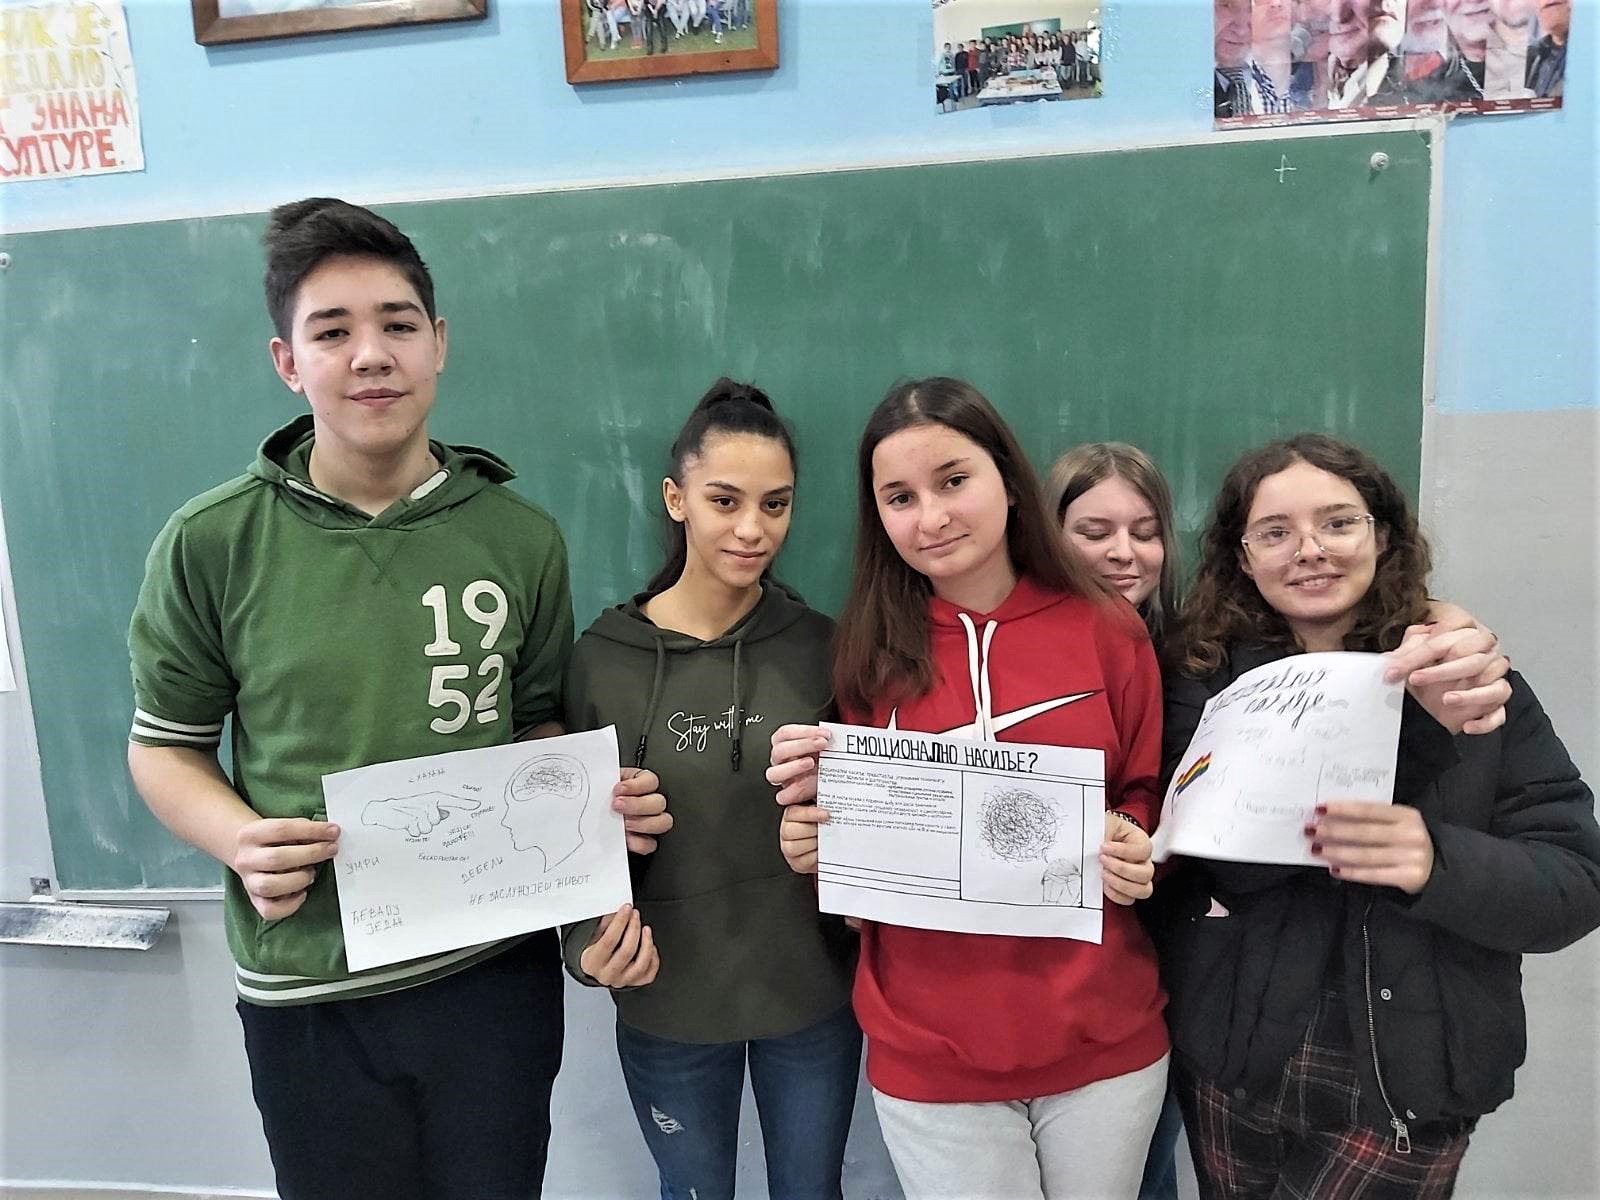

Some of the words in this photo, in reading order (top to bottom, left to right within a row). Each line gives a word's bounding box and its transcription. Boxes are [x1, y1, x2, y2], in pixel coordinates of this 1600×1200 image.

[421, 579, 509, 657] 19
[428, 653, 504, 735] 52
[667, 710, 711, 752] Stay
[846, 734, 958, 764] ЕМОЦИОНАЛНО
[964, 746, 1038, 773] НАСИЉЕ?
[345, 856, 380, 875] УМРИ
[469, 892, 482, 905] НЕ
